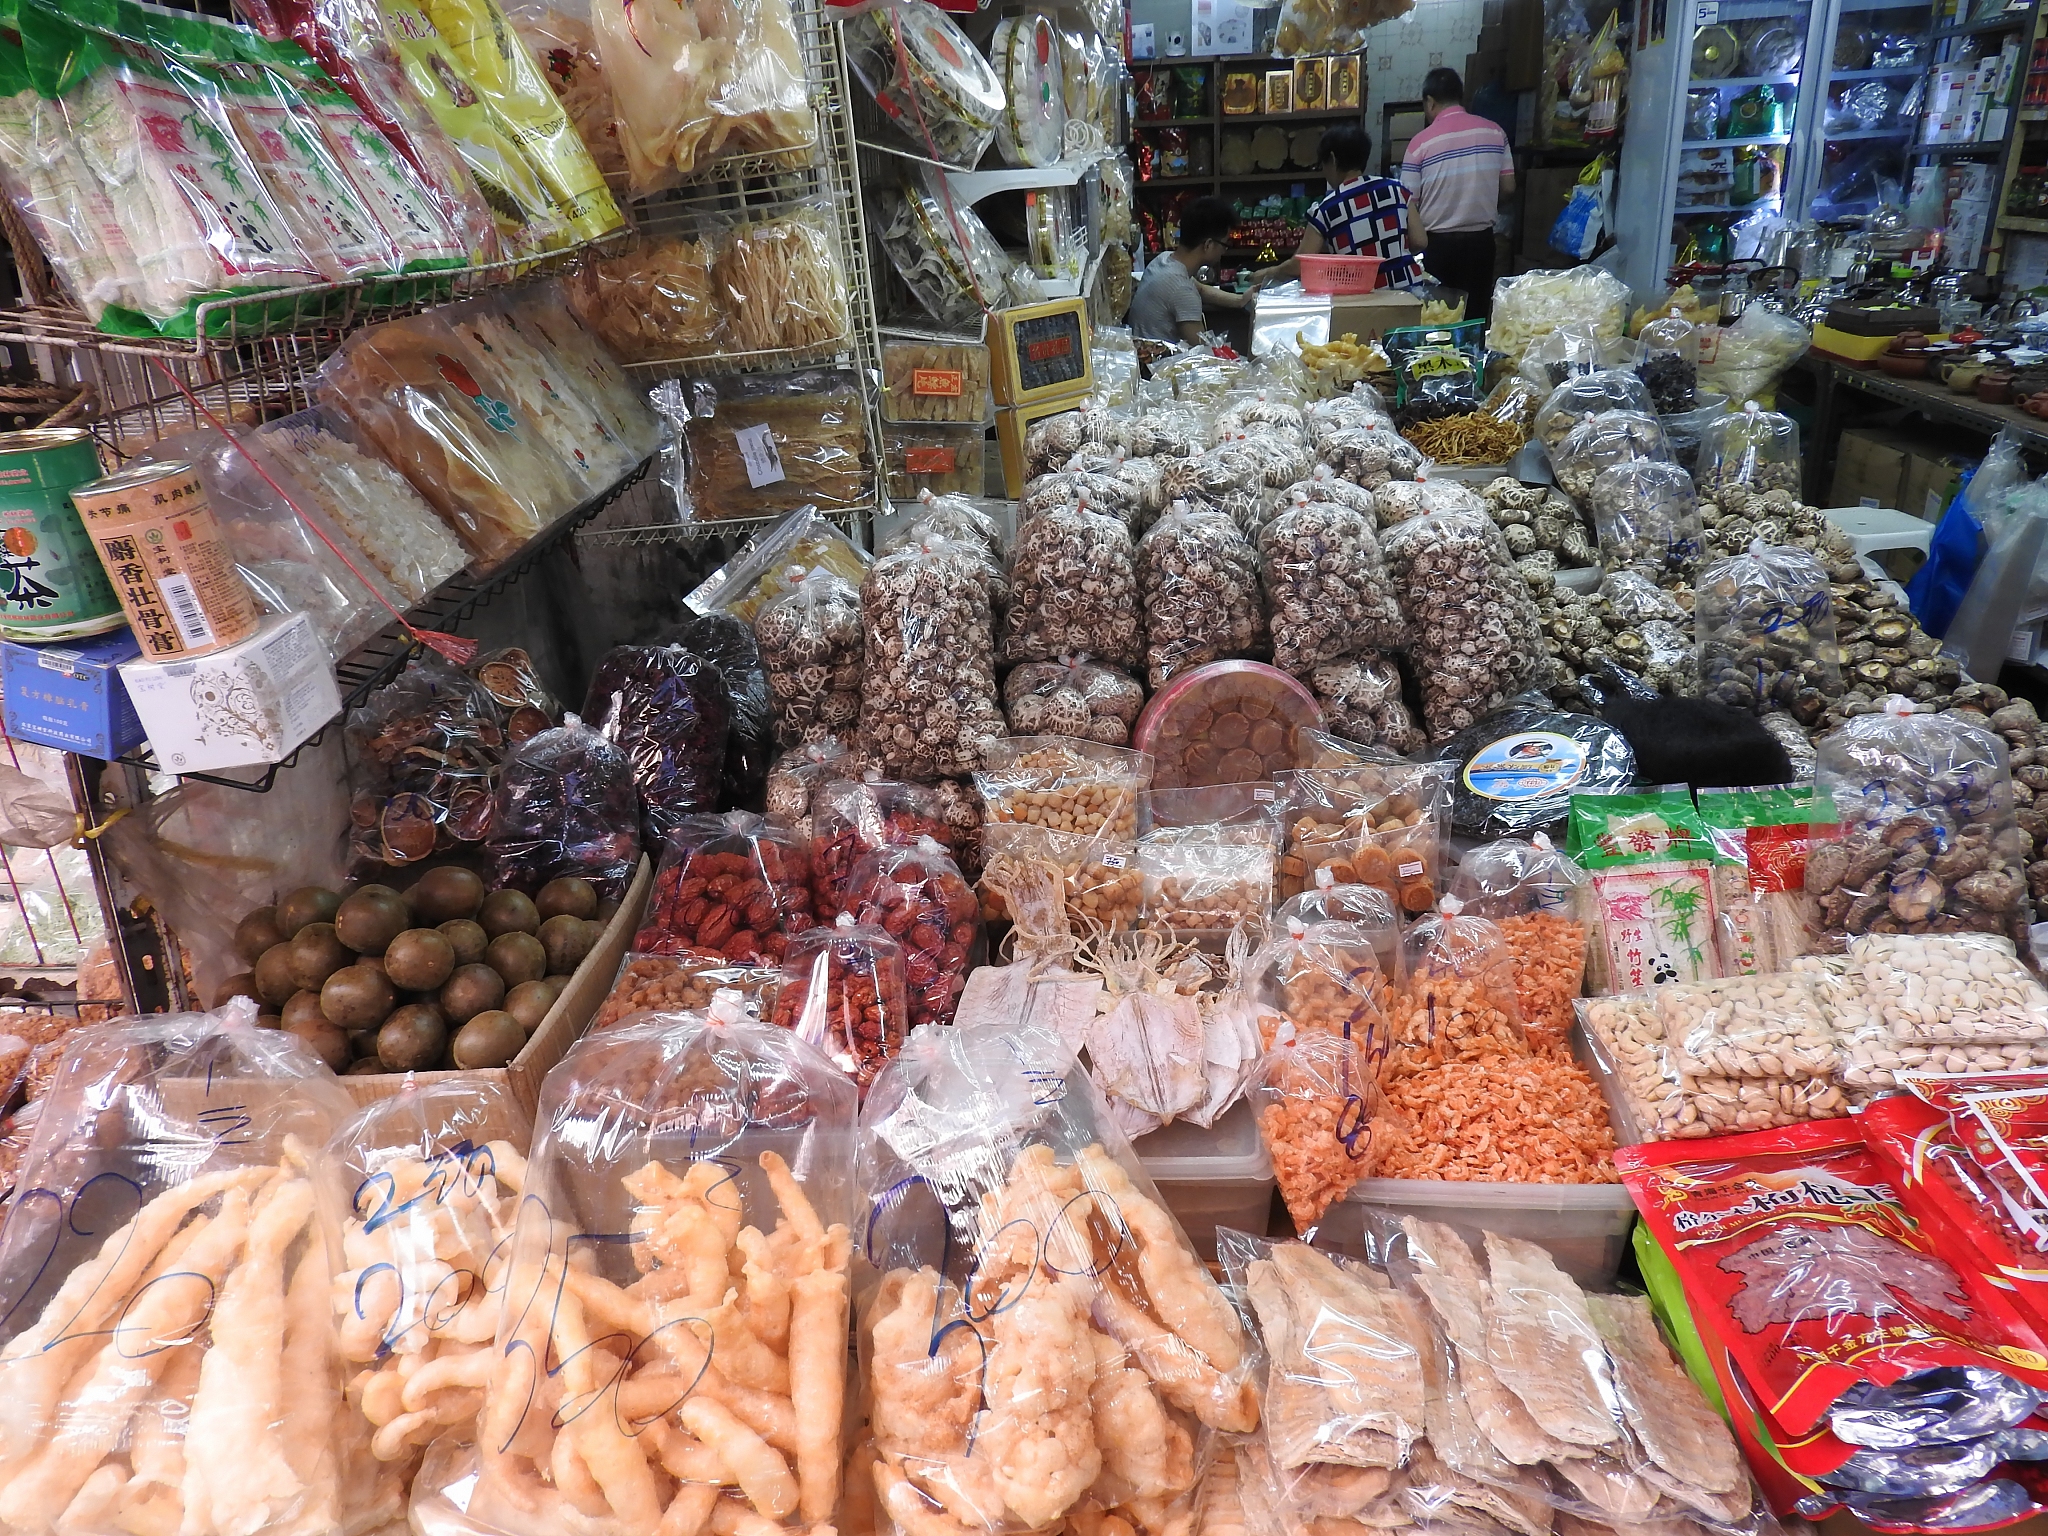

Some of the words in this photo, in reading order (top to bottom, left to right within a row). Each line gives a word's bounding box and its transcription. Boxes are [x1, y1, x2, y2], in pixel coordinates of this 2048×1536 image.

[1418, 356, 1467, 375] 黑木
[752, 451, 763, 476] Crocodile
[0, 557, 60, 612] 茶
[72, 671, 90, 682] OTC
[1593, 824, 1696, 859] 豐發牌
[1620, 928, 1645, 945] 野生
[1690, 1179, 1757, 1198] 青海千金
